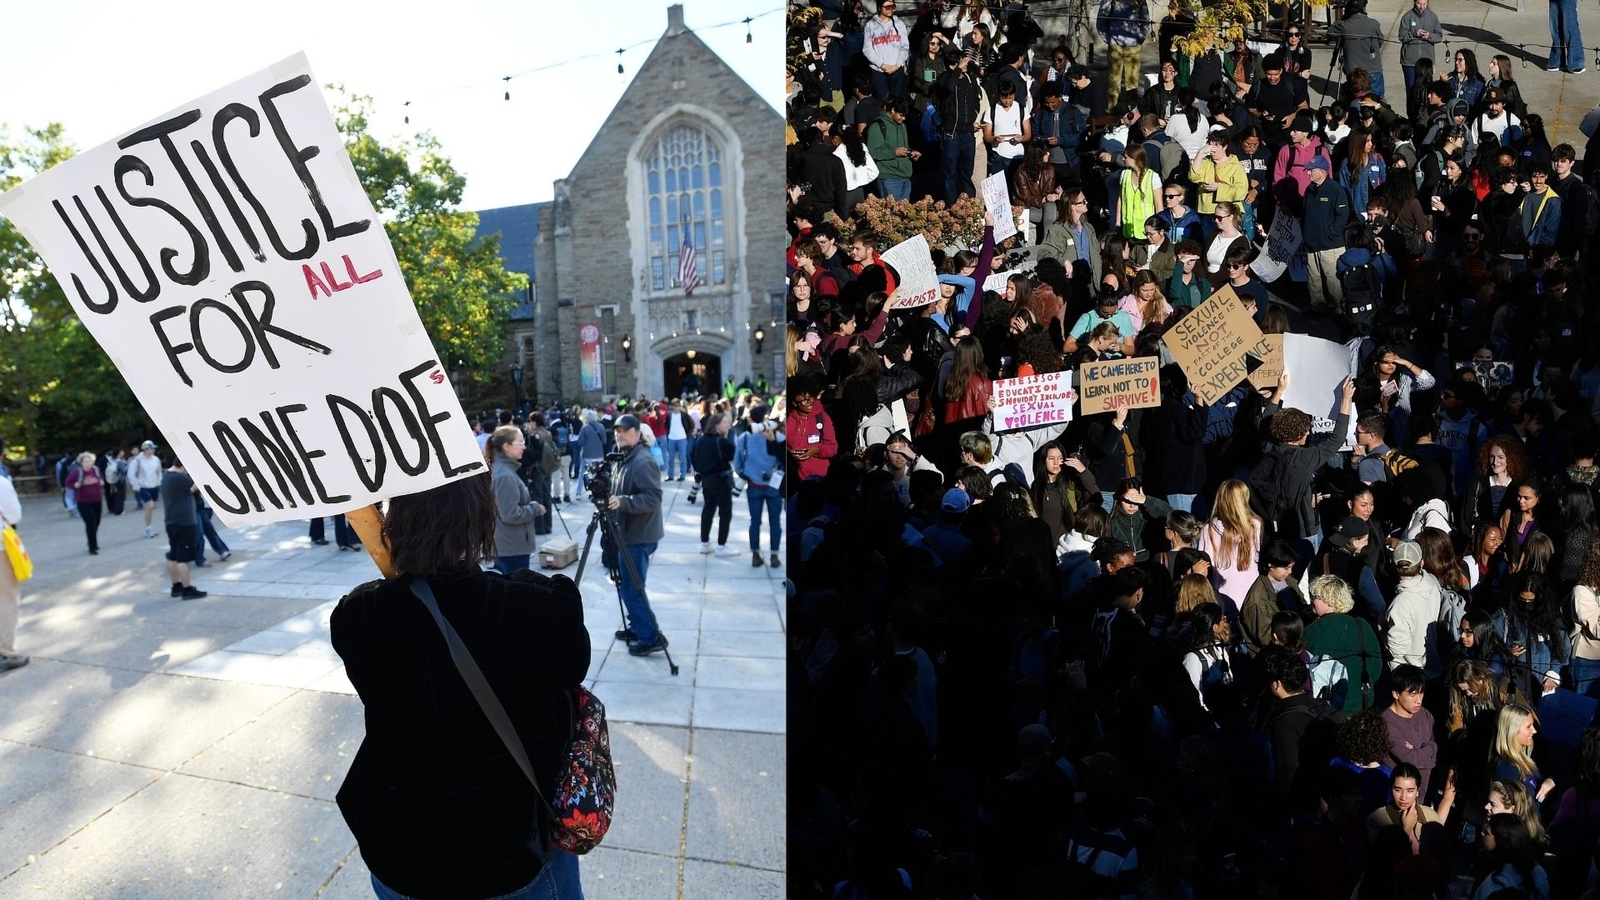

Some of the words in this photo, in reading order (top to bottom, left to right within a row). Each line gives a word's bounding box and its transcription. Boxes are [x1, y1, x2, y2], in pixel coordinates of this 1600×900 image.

[52, 74, 371, 315] JUSTICE
[302, 254, 383, 300] ALL
[898, 288, 937, 307] RAPISTS
[150, 281, 333, 388] FOR
[1175, 295, 1231, 341] SEXUAL
[1182, 312, 1225, 350] VIOLENCE
[1226, 303, 1235, 312] IS
[1193, 348, 1211, 366] PART
[1213, 343, 1220, 351] OF
[1221, 331, 1234, 343] THE
[1196, 321, 1228, 353] NOT
[1083, 366, 1099, 382] WE
[1101, 364, 1125, 378] CAME
[1125, 362, 1143, 376] HERE
[1143, 361, 1156, 372] TO
[1199, 336, 1244, 377] COLLEGE
[996, 377, 1024, 388] THE
[1047, 373, 1061, 381] OF
[998, 384, 1057, 398] EDUCATION
[1113, 380, 1131, 394] NOT
[1134, 378, 1149, 389] TO
[1013, 401, 1055, 415] SEXUAL
[187, 403, 352, 515] JANE
